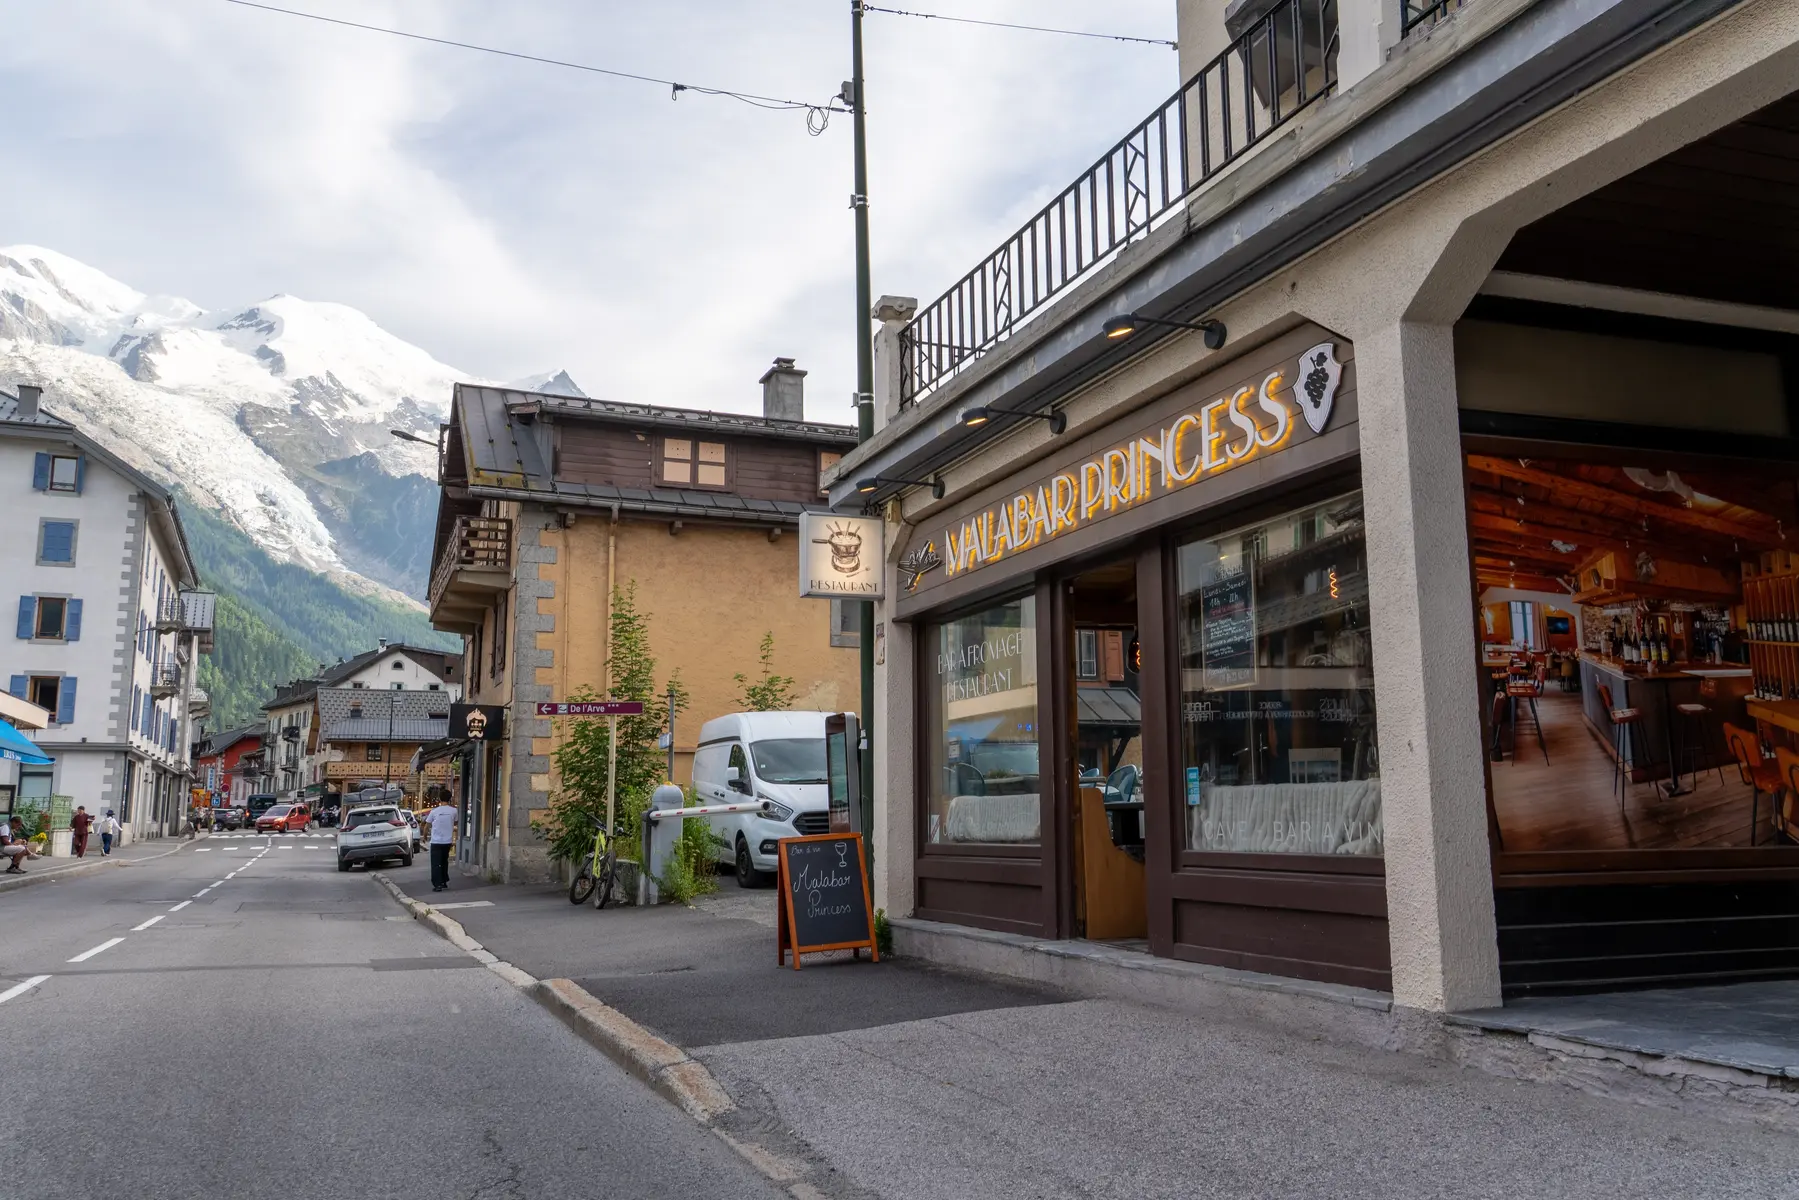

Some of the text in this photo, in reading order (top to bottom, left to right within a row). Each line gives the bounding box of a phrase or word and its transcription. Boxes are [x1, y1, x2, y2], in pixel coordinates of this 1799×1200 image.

[945, 372, 1288, 575] MALABAR PRINCESS
[811, 580, 878, 592] RESTAURANT
[938, 651, 956, 674] BAR
[968, 632, 1022, 666] FROMAGE
[947, 668, 1012, 702] RESTAURANT
[583, 704, 605, 712] l'Arve
[1204, 821, 1247, 841] CAVE
[1273, 821, 1312, 842] BAR
[1344, 822, 1382, 844] VIN
[793, 864, 850, 892] Malabar
[808, 889, 851, 918] Princess
